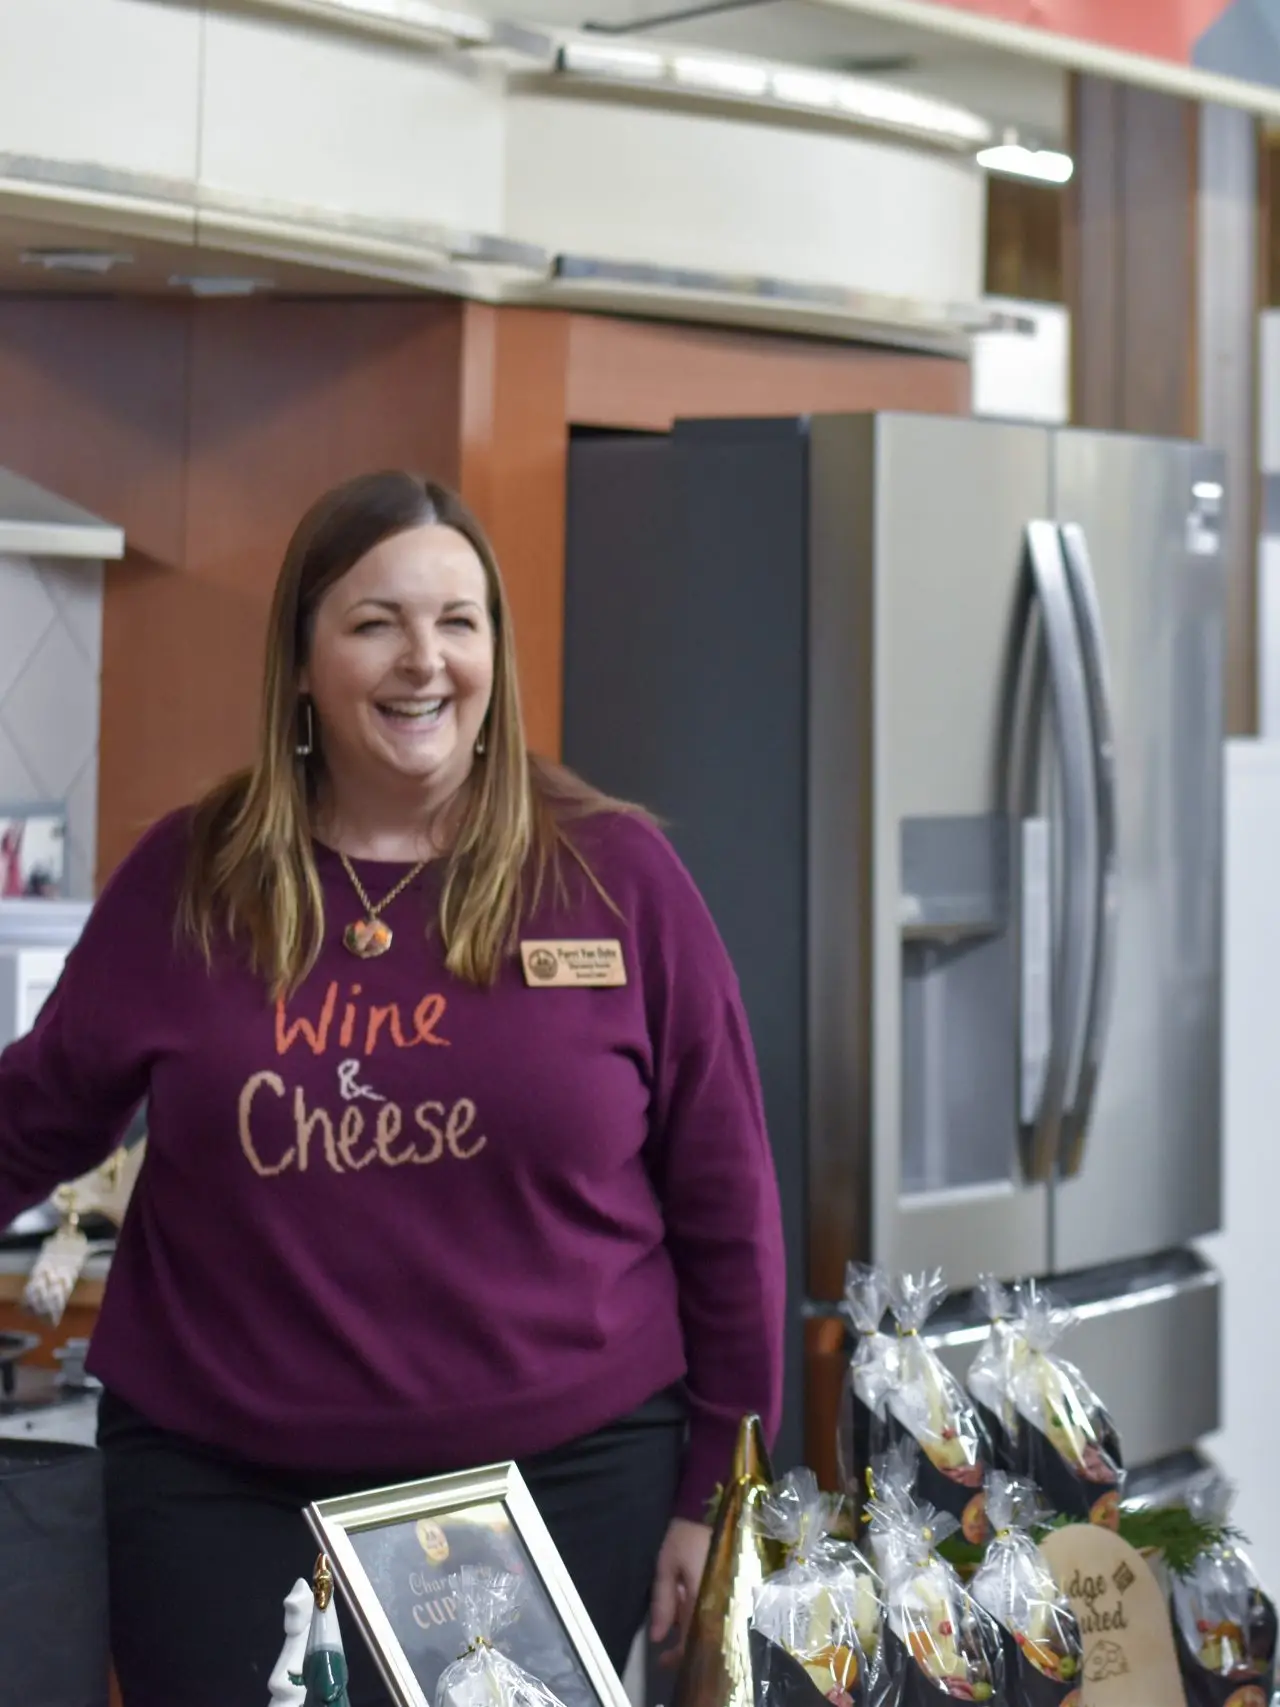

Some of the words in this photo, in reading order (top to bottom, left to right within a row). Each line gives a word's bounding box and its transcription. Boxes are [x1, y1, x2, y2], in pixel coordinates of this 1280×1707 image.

[274, 979, 452, 1056] Wine
[337, 1058, 388, 1101] &
[238, 1069, 488, 1177] Cheese
[1069, 1568, 1107, 1611] dge
[1080, 1601, 1128, 1635] ured
